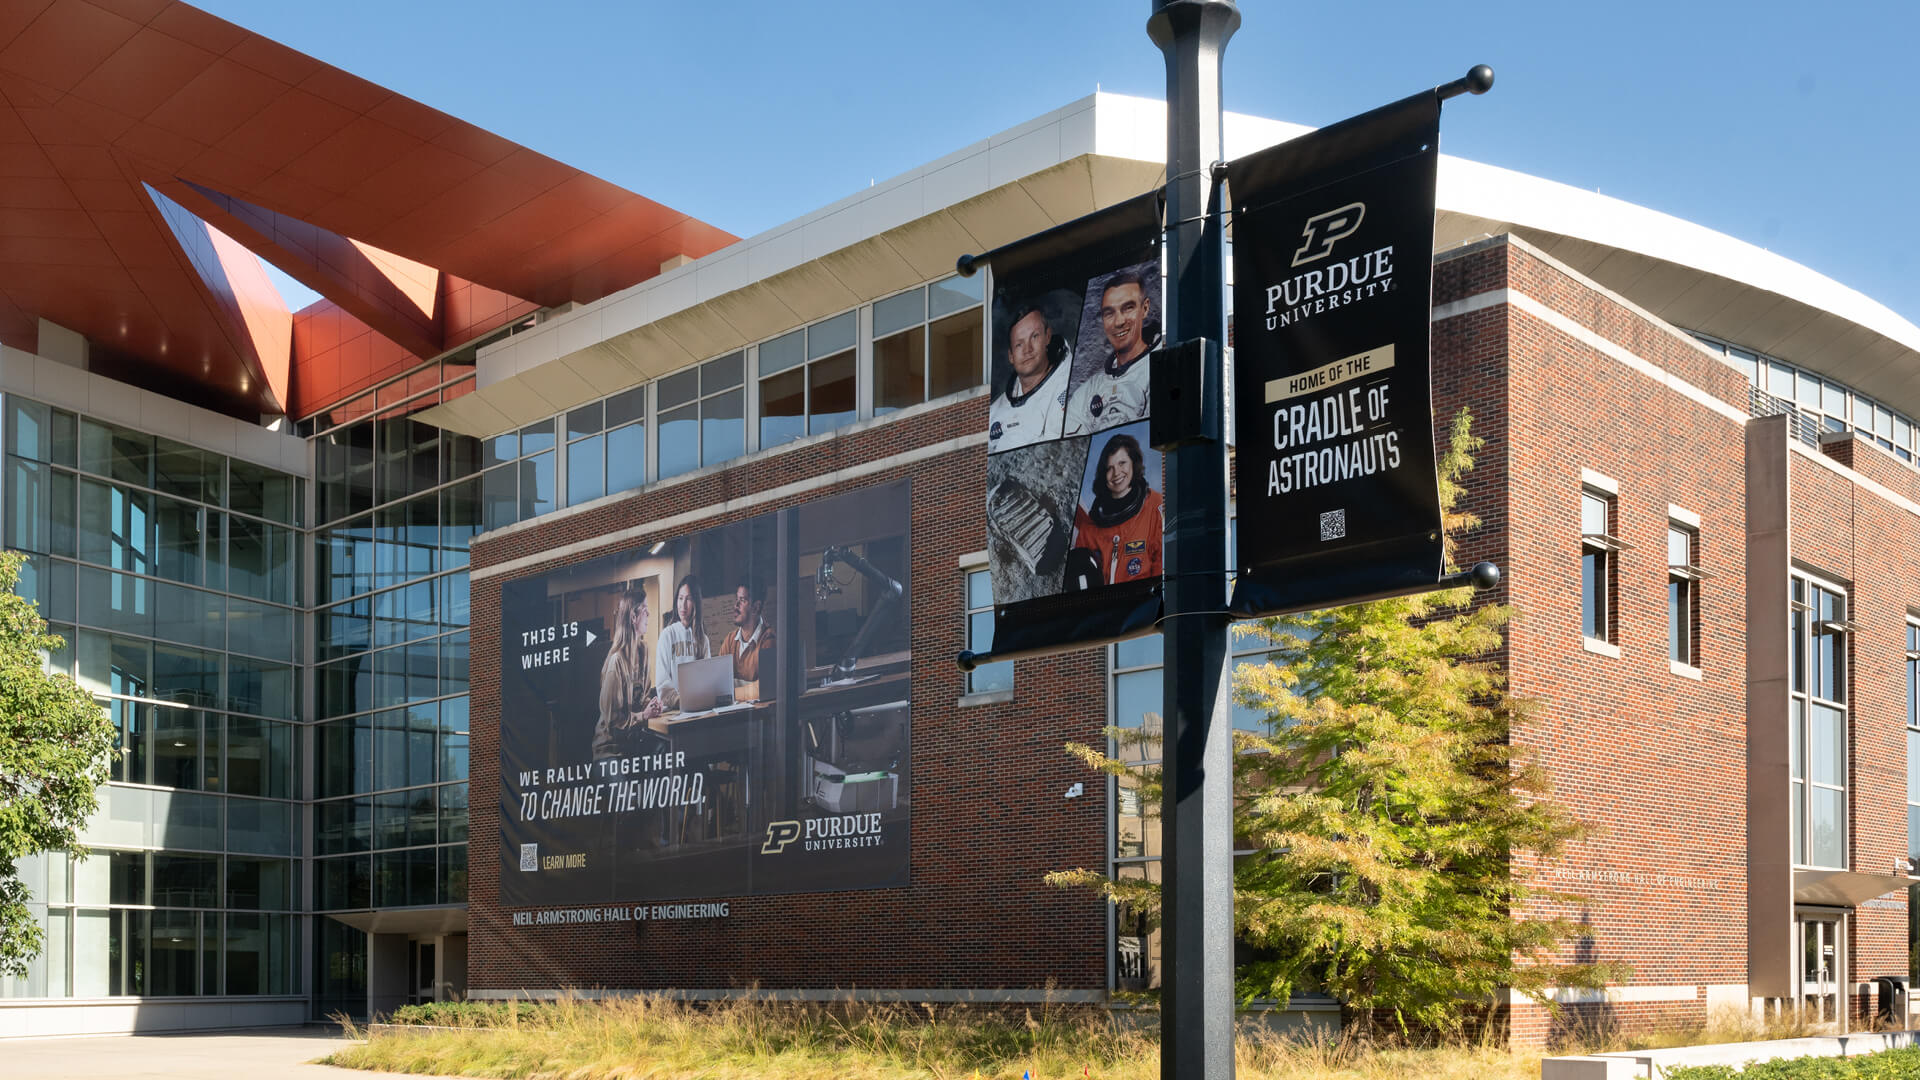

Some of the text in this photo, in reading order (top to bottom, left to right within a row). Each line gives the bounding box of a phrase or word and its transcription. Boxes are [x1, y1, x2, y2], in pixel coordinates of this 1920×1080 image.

[1290, 202, 1366, 268] P
[1265, 245, 1393, 314] PURDUE
[1266, 278, 1393, 331] UNIVERSITY
[1289, 355, 1371, 393] HOME OF THE
[1274, 385, 1389, 450] CRADLE OF
[1267, 431, 1400, 496] ASTRONAUTS
[522, 621, 578, 647] THIS IS
[521, 646, 570, 670] WHERE
[519, 751, 685, 787] WE RALLY TOGETHER
[520, 772, 706, 822] TO CHANGE THE WORLD.
[761, 820, 800, 854] P
[805, 812, 881, 839] PURDUE
[805, 835, 881, 851] UNIVERSITY
[542, 853, 586, 870] LEARN MORE
[513, 902, 729, 926] NEIL ARMSTRONG HALL OF ENGINEERING
